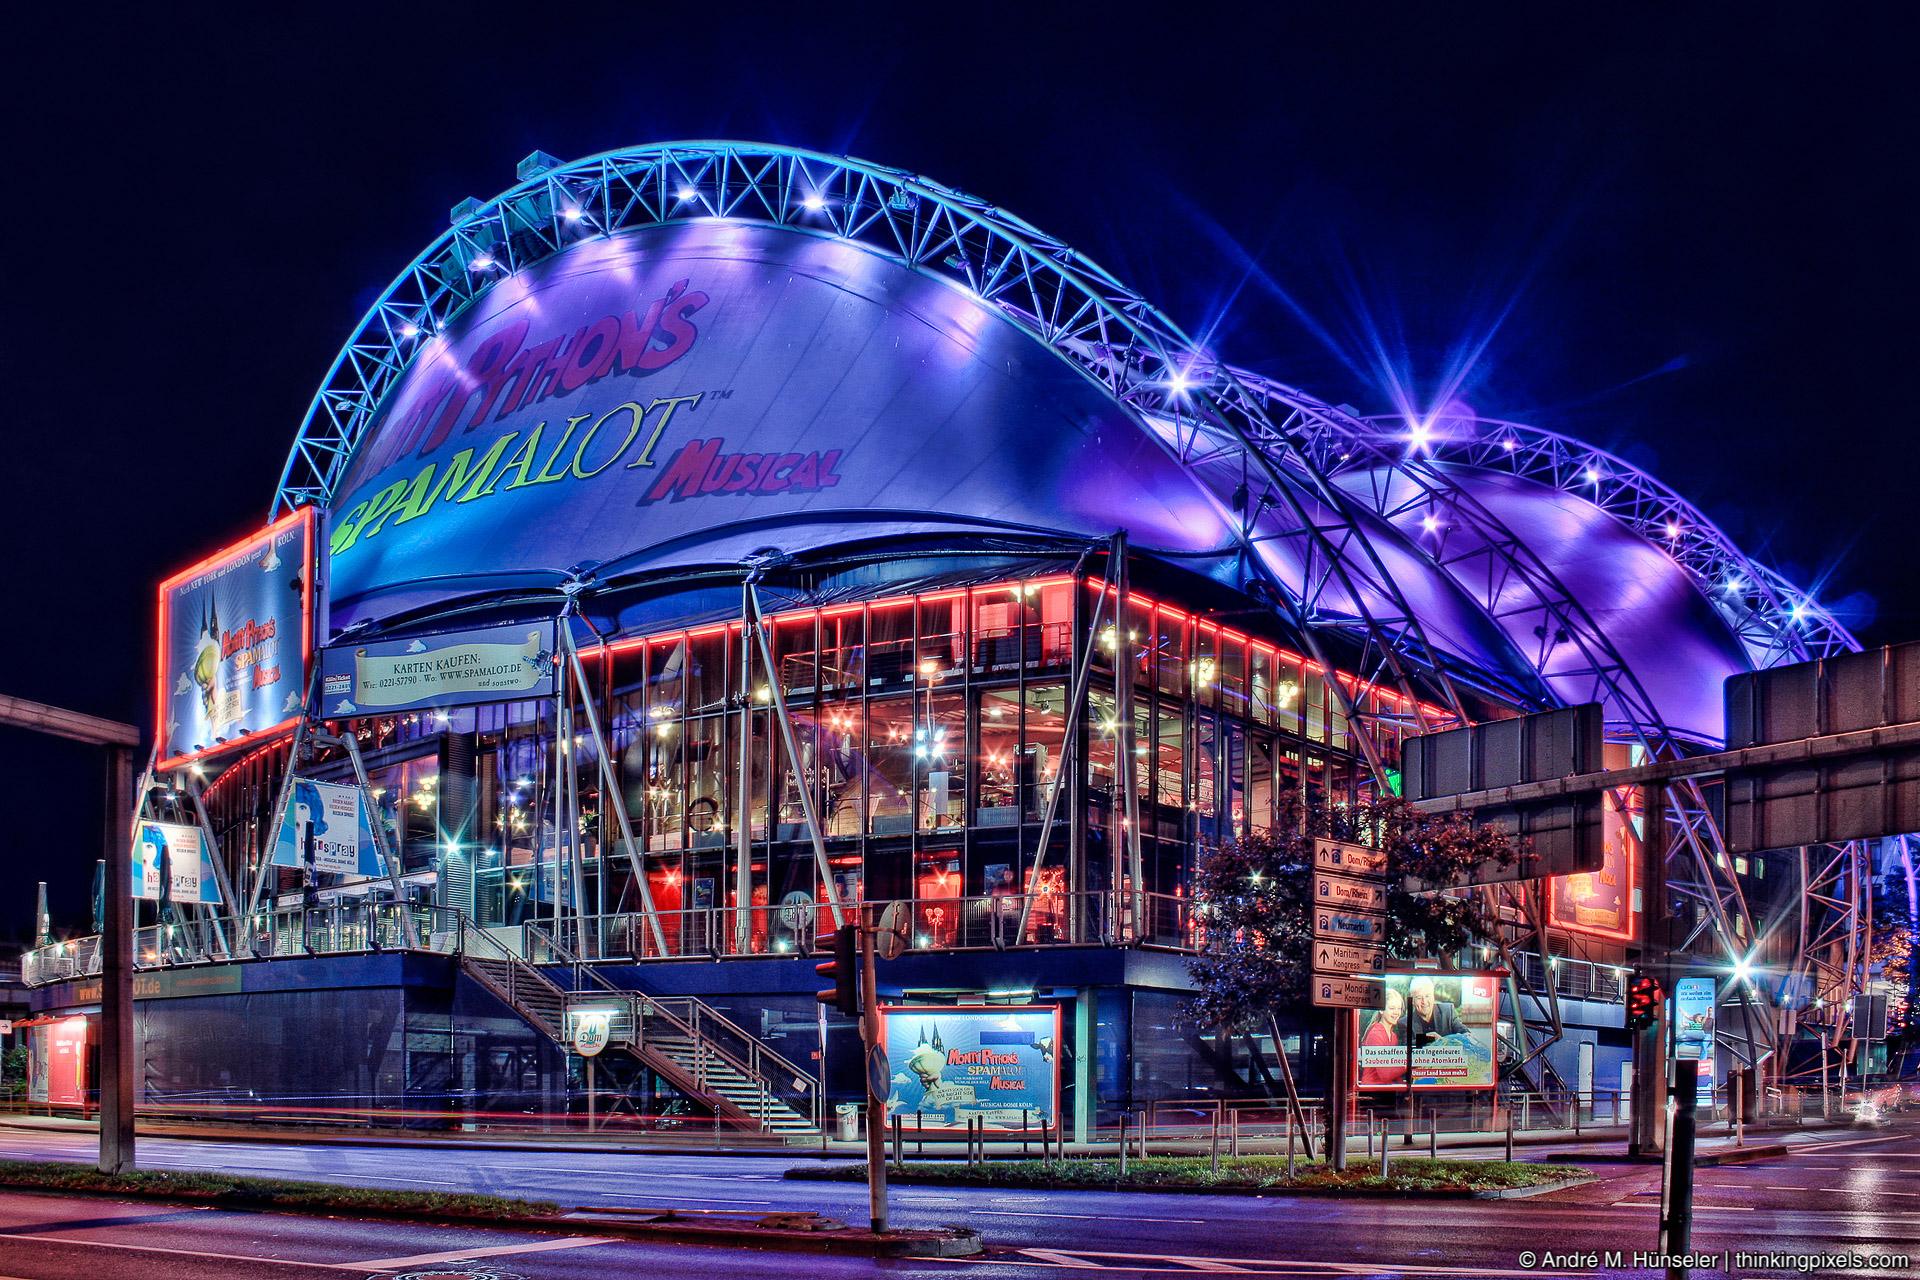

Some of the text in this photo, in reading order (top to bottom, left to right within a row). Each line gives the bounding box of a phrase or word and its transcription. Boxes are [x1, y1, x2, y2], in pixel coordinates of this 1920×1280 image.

[329, 394, 703, 556] SPAMALOT
[638, 438, 842, 506] MUSICAL
[226, 553, 252, 573] LONDON
[235, 637, 281, 671] SPAMALOT
[393, 653, 481, 675] KARTEN KAUFEN:
[379, 675, 417, 688] 0221-57790
[440, 664, 522, 681] WWW.SPAMALOT.DE
[300, 837, 355, 858] hirspray
[1336, 885, 1368, 900] Dom/Rhein
[1337, 919, 1365, 932] Neumarkt
[1333, 947, 1360, 959] Maritim
[1332, 959, 1360, 971] Kongress
[1344, 983, 1371, 994] Mondial
[1473, 987, 1487, 996] SPD
[1344, 994, 1371, 1004] Kongress
[947, 1049, 981, 1065] MONTY
[1365, 1048, 1377, 1056] Das
[1377, 1048, 1403, 1056] schaffen
[1426, 1048, 1460, 1057] Ingenieure:
[1365, 1057, 1390, 1065] Saubere
[1390, 1057, 1410, 1066] Energ
[1431, 1056, 1466, 1065] Atomkraft.
[967, 1065, 1026, 1075] SPAMALOT
[989, 1075, 1026, 1090] MUSICAL
